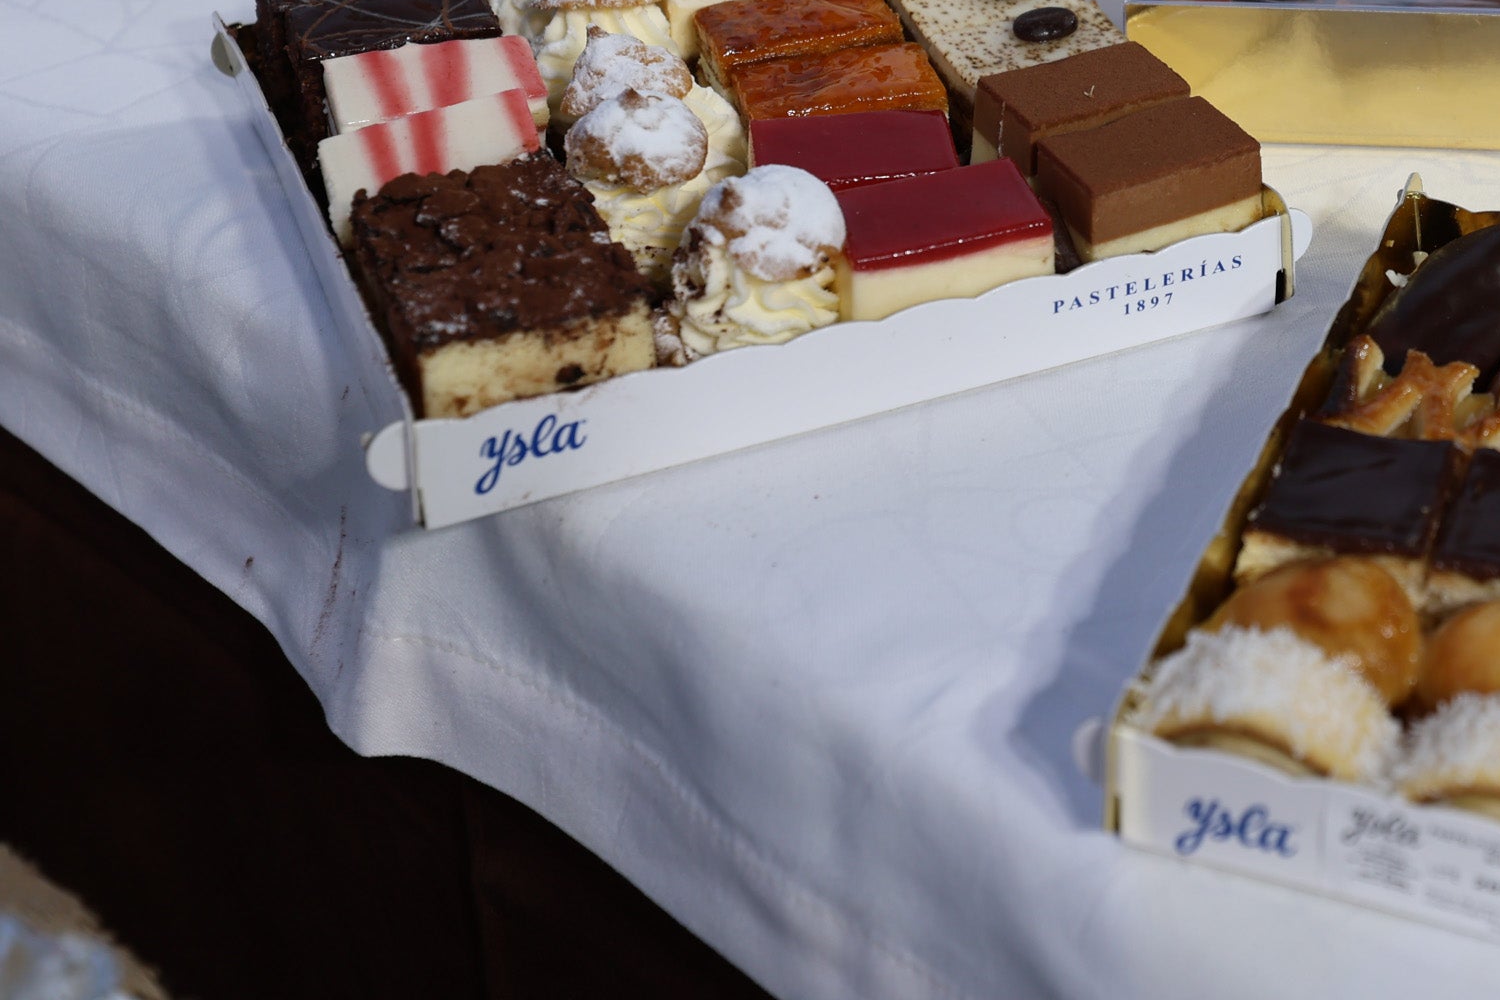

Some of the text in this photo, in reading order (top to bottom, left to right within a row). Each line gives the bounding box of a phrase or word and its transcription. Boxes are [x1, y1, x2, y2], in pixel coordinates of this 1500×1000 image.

[1053, 255, 1242, 315] PASTELERÍAS
[1123, 292, 1175, 316] 1897
[474, 414, 587, 495] ysla
[1175, 797, 1298, 858] ysla
